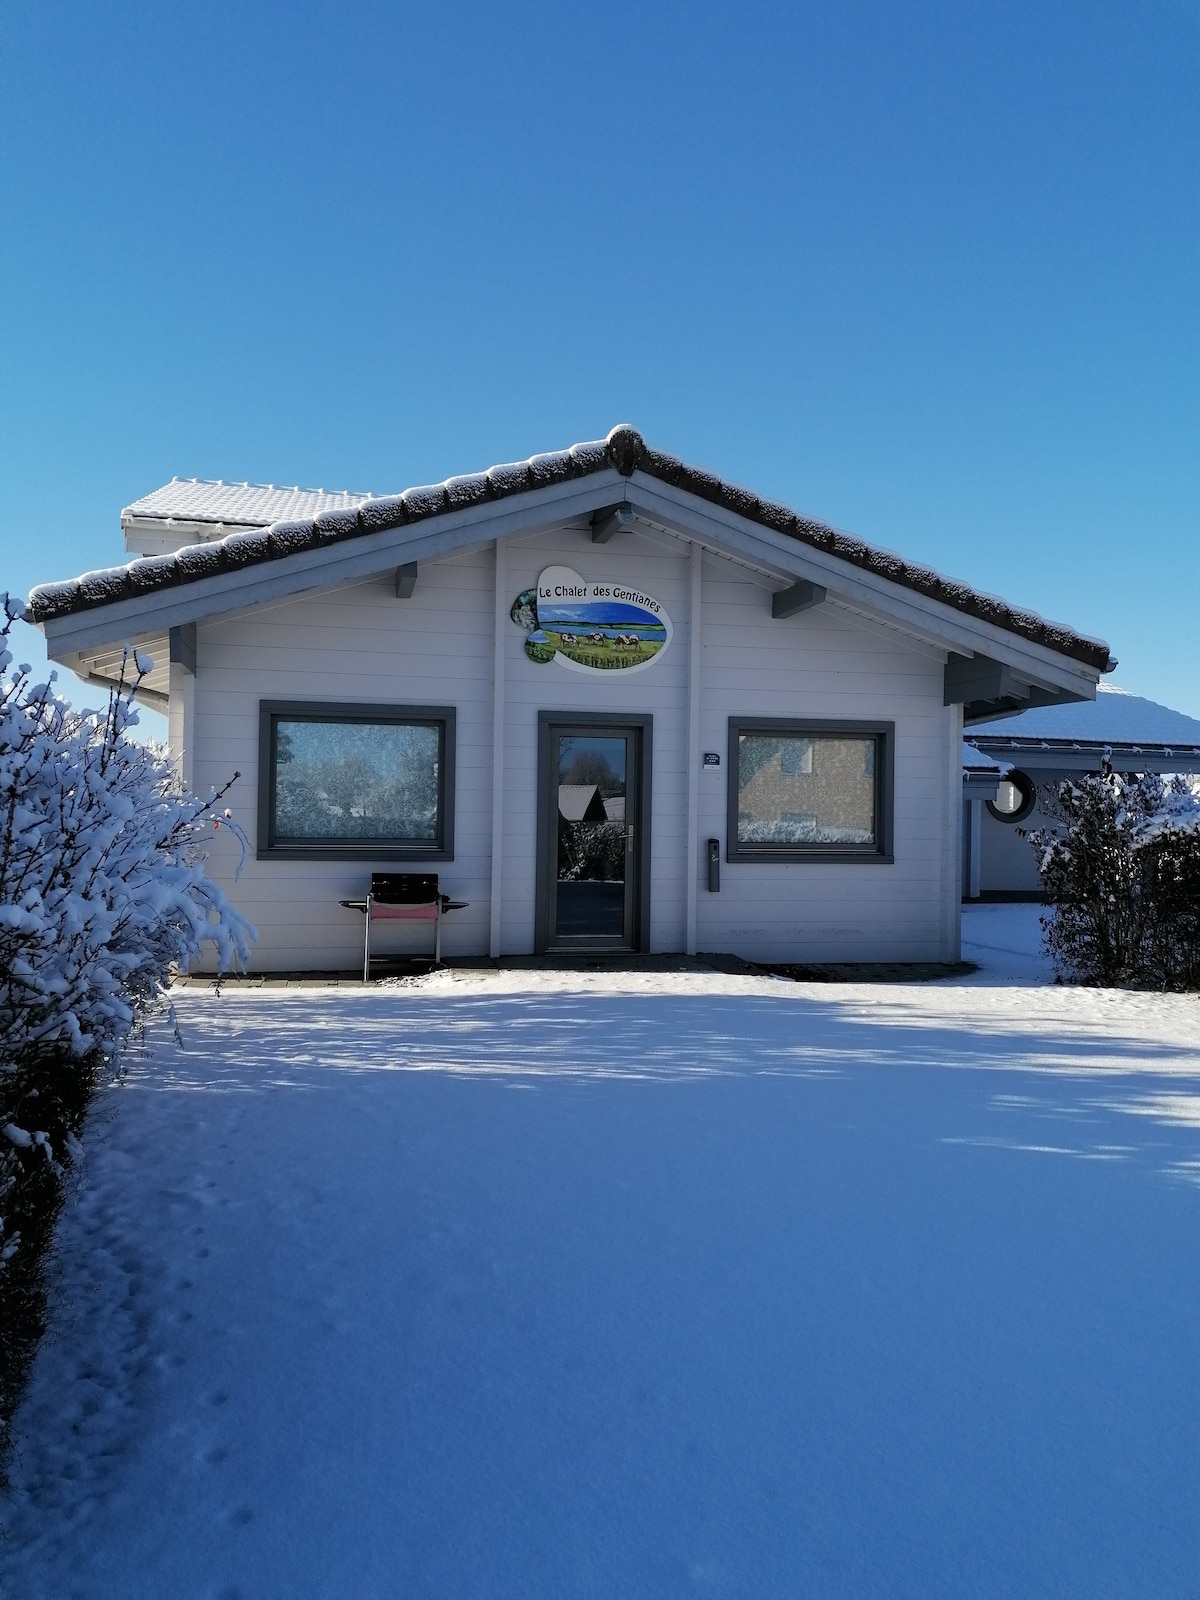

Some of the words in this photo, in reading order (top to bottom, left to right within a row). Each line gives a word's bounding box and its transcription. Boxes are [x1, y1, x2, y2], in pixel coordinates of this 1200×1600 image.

[539, 587, 552, 598] Le
[554, 585, 587, 597] Chalet
[593, 586, 611, 596] des
[613, 587, 661, 613] Gentianes
